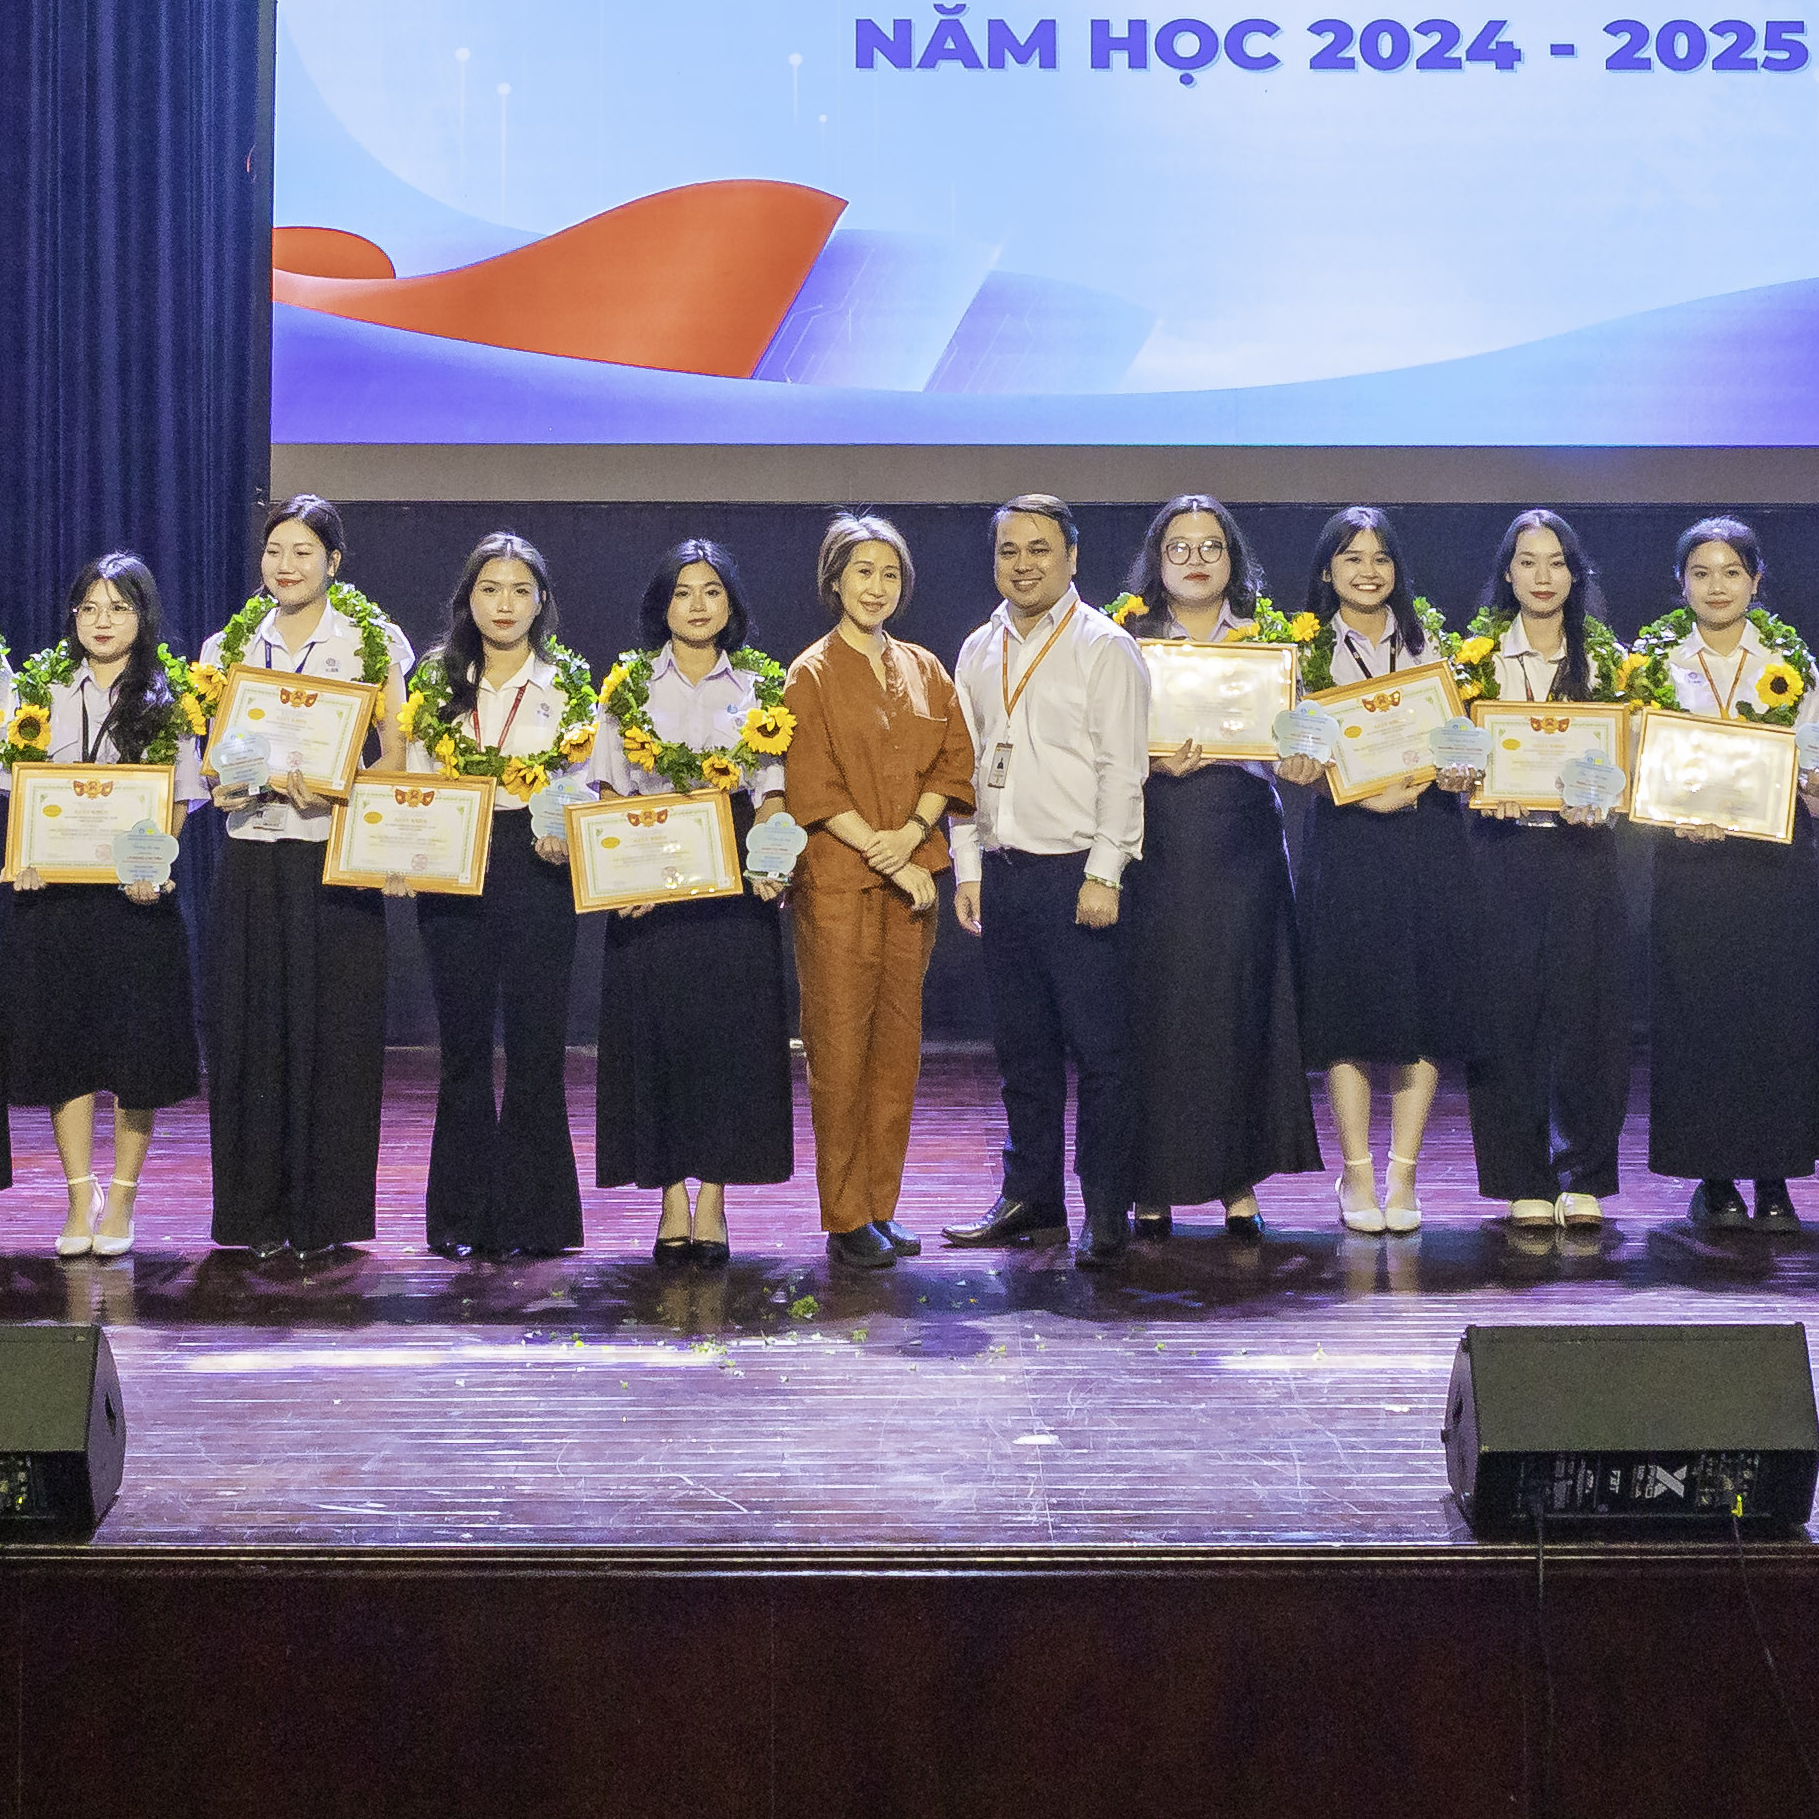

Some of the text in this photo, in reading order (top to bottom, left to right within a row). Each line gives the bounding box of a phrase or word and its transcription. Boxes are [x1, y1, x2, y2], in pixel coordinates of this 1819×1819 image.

[855, 3, 1810, 86] NĂM HỌC 2024 - 2025
